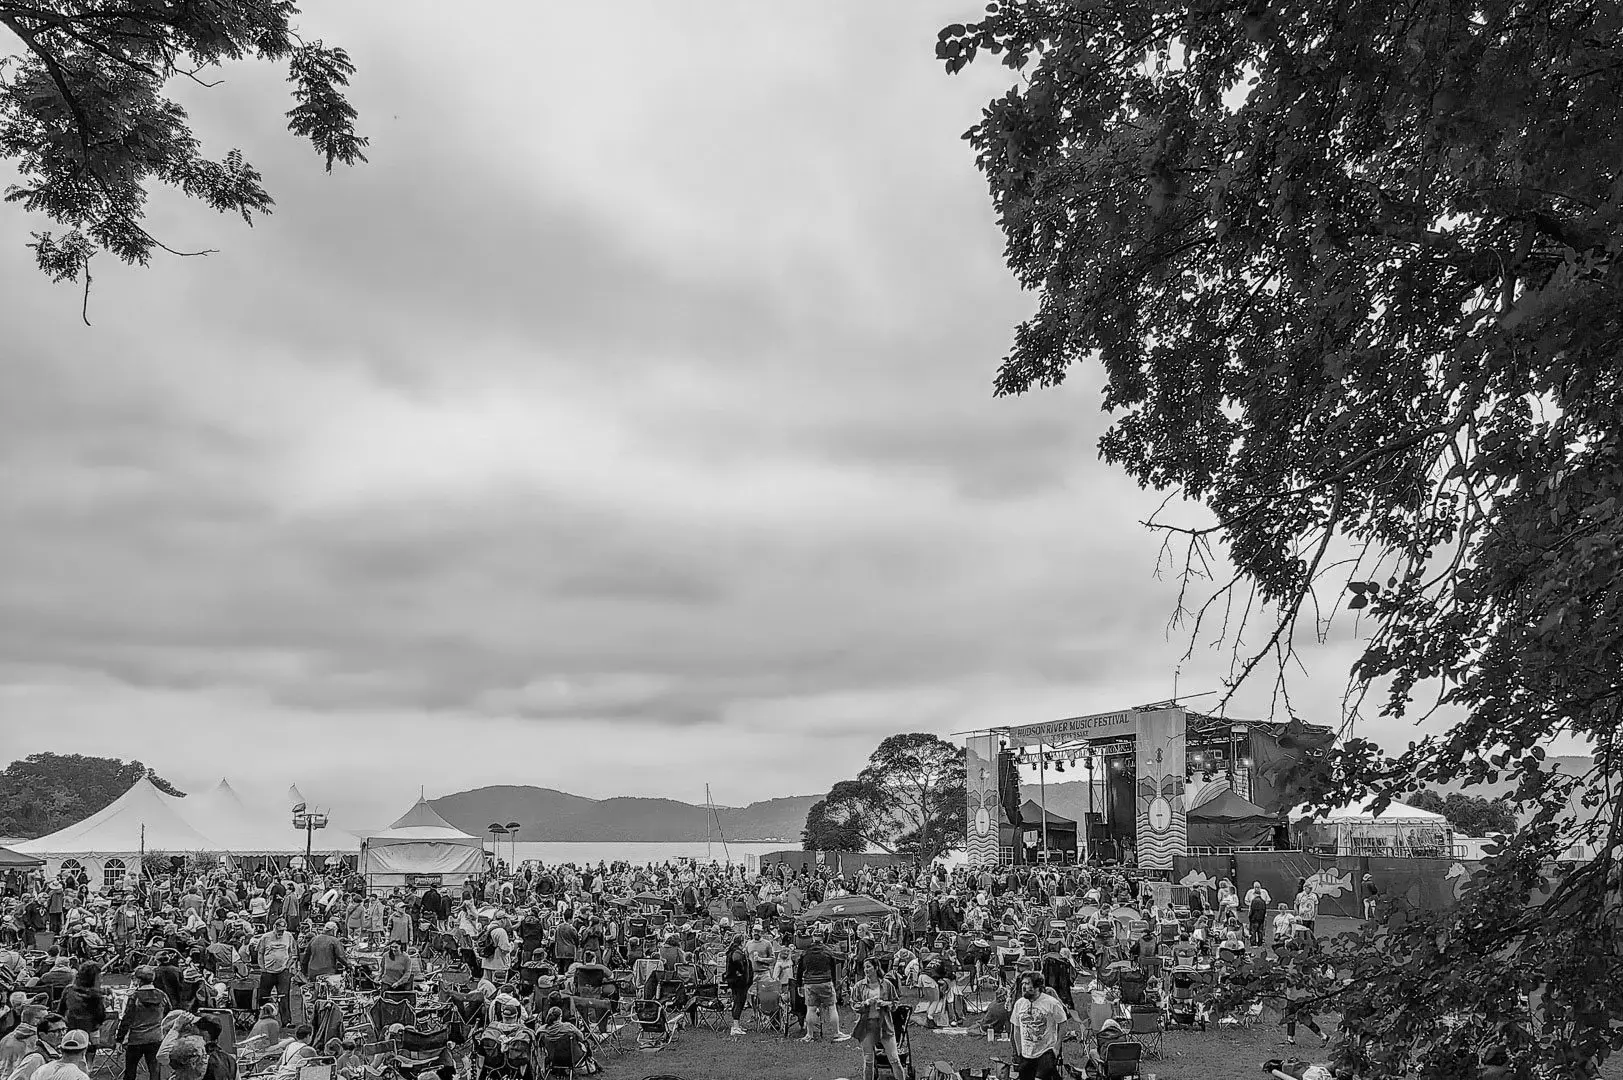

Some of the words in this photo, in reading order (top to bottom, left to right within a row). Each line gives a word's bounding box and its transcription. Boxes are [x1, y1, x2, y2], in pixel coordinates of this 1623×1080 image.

[1017, 725, 1045, 737] HUDSON
[1046, 721, 1068, 734] RIVER
[1069, 718, 1092, 731] MUSIC
[1093, 713, 1130, 727] FESTIVAL
